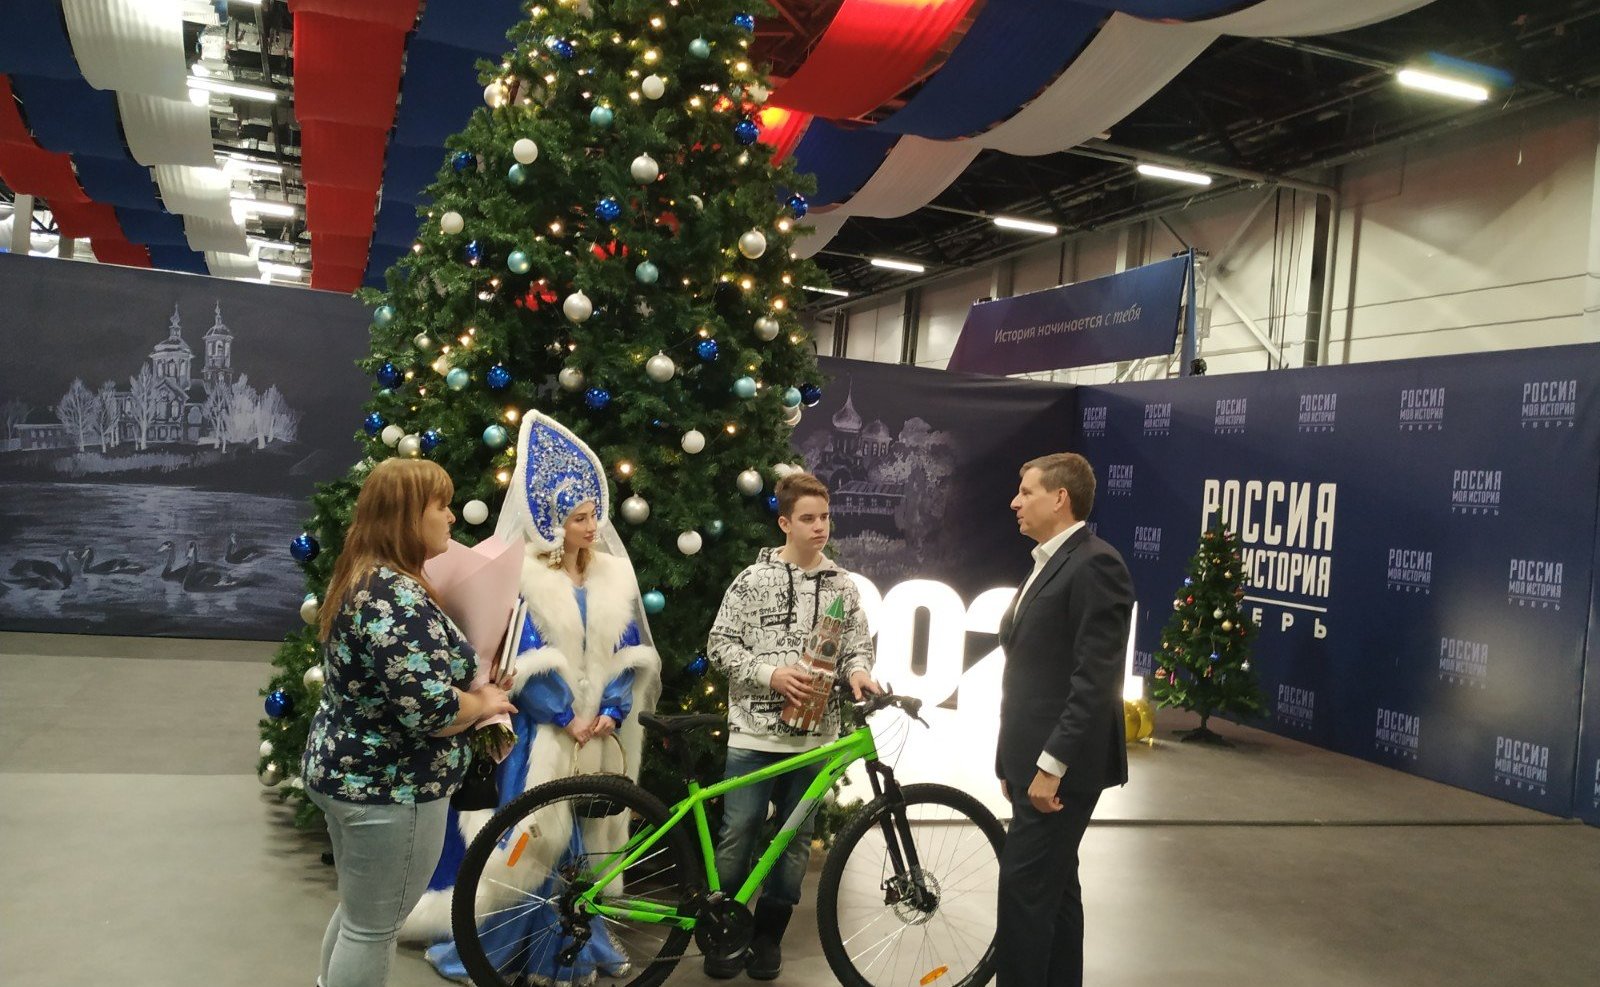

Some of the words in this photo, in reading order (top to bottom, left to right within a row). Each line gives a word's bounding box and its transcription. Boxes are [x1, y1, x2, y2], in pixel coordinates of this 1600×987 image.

[995, 326, 1036, 344] История
[1038, 314, 1102, 338] начинается
[1104, 312, 1111, 326] с
[1113, 303, 1142, 324] тебя
[1401, 388, 1445, 408] РОССИЯ
[1522, 380, 1576, 403] РОССИЯ
[1145, 403, 1172, 418] РОССИЯ
[1216, 398, 1247, 415] РОССИЯ
[1300, 393, 1337, 411] РОССИЯ
[1522, 403, 1538, 417] МОЯ
[1540, 402, 1576, 416] ИСТОРИЯ
[1083, 407, 1107, 420] РОССИЯ
[1214, 415, 1225, 425] МОЯ
[1225, 414, 1246, 424] ИСТОРИЯ
[1299, 413, 1311, 423] МОЯ
[1312, 411, 1336, 422] ИСТОРИЯ
[1400, 409, 1413, 420] МОЯ
[1414, 408, 1444, 419] ИСТОРИЯ
[1109, 465, 1133, 479] РОССИЯ
[1453, 470, 1502, 490] РОССИЯ
[1452, 491, 1468, 502] МОЯ
[1468, 491, 1500, 504] ИСТОРИЯ
[1201, 479, 1337, 551] РОССИЯ
[1135, 526, 1161, 542] РОССИЯ
[1389, 549, 1432, 571] РОССИЯ
[1241, 548, 1331, 598] ИСТОРИЯ
[1388, 568, 1401, 580] МОЯ
[1402, 569, 1431, 584] ИСТОРИЯ
[1509, 559, 1563, 583] РОССИЯ
[1508, 580, 1525, 594] МОЯ
[1526, 582, 1561, 598] ИСТОРИЯ
[1252, 607, 1327, 639] ЕРЬ
[1134, 650, 1151, 669] ССИЯ
[1440, 637, 1489, 664] РОССИЯ
[1278, 684, 1315, 708] РОССИЯ
[1377, 708, 1420, 737] РОССИЯ
[1376, 728, 1389, 740] МОЯ
[1390, 731, 1419, 749] ИСТОРИЯ
[1496, 736, 1549, 769] РОССИЯ
[1495, 757, 1512, 773] МОЯ
[1512, 761, 1547, 783] ИСТОРИЯ
